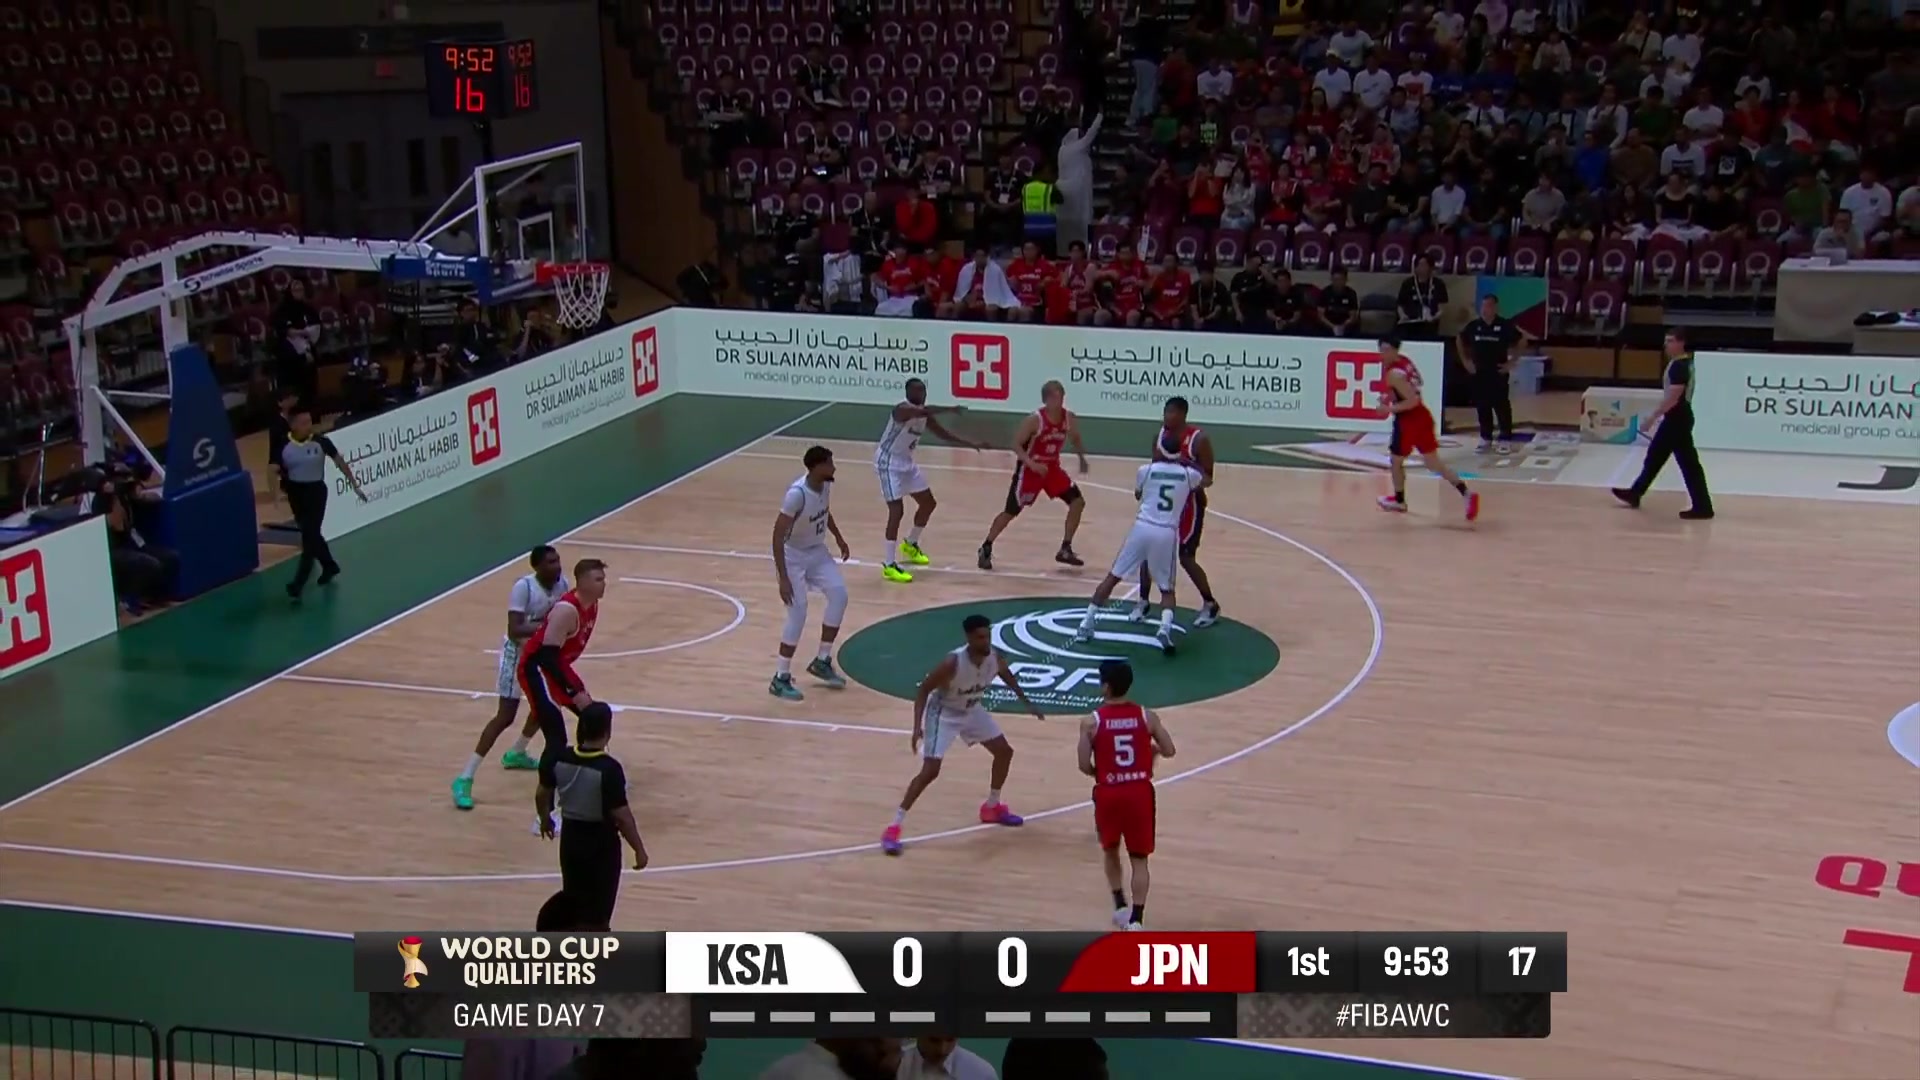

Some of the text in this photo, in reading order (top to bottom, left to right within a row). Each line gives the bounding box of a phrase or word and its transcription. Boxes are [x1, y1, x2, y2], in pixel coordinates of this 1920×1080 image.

[445, 48, 494, 72] 9:52
[456, 77, 484, 112] 16
[715, 328, 799, 346] الحبيب
[716, 348, 929, 374] DR SULAIMAN AL HABIB
[1071, 346, 1161, 365] الحبيب
[744, 371, 826, 388] medical group
[1071, 367, 1302, 393] DR SULAIMAN AL HABIB
[1747, 374, 1859, 394] الحبيب
[526, 367, 625, 420] DR SULAIMAN AL HABIB
[1101, 390, 1149, 403] medical
[1745, 397, 1913, 419] DR SULAIMAN
[1781, 422, 1841, 435] medical
[1844, 425, 1890, 440] group
[355, 454, 411, 488] SULAIMAN
[414, 449, 427, 466] AL
[429, 433, 460, 460] HABIB
[1157, 484, 1174, 512] 5
[1114, 734, 1135, 767] 5
